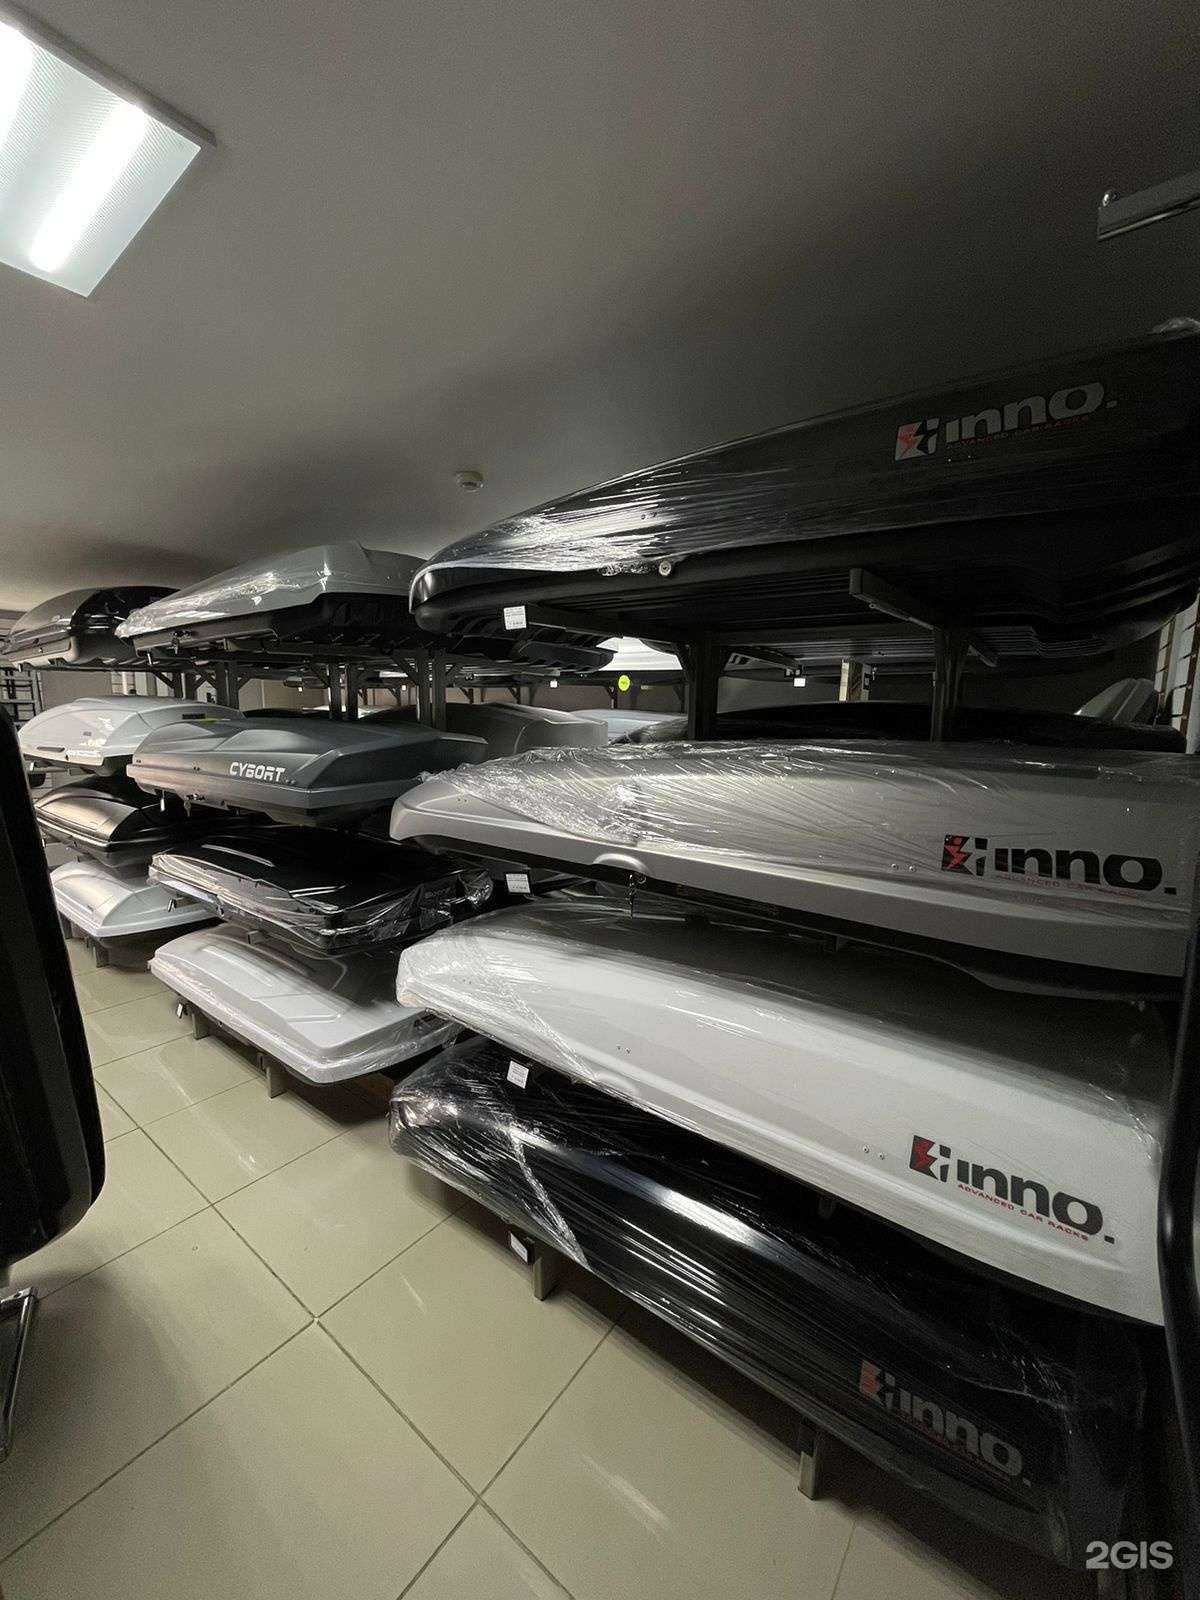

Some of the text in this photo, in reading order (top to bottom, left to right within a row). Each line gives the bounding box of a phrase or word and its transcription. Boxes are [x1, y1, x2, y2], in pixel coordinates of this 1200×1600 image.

[958, 1183, 1090, 1242] ADVANCED CAR RACKS
